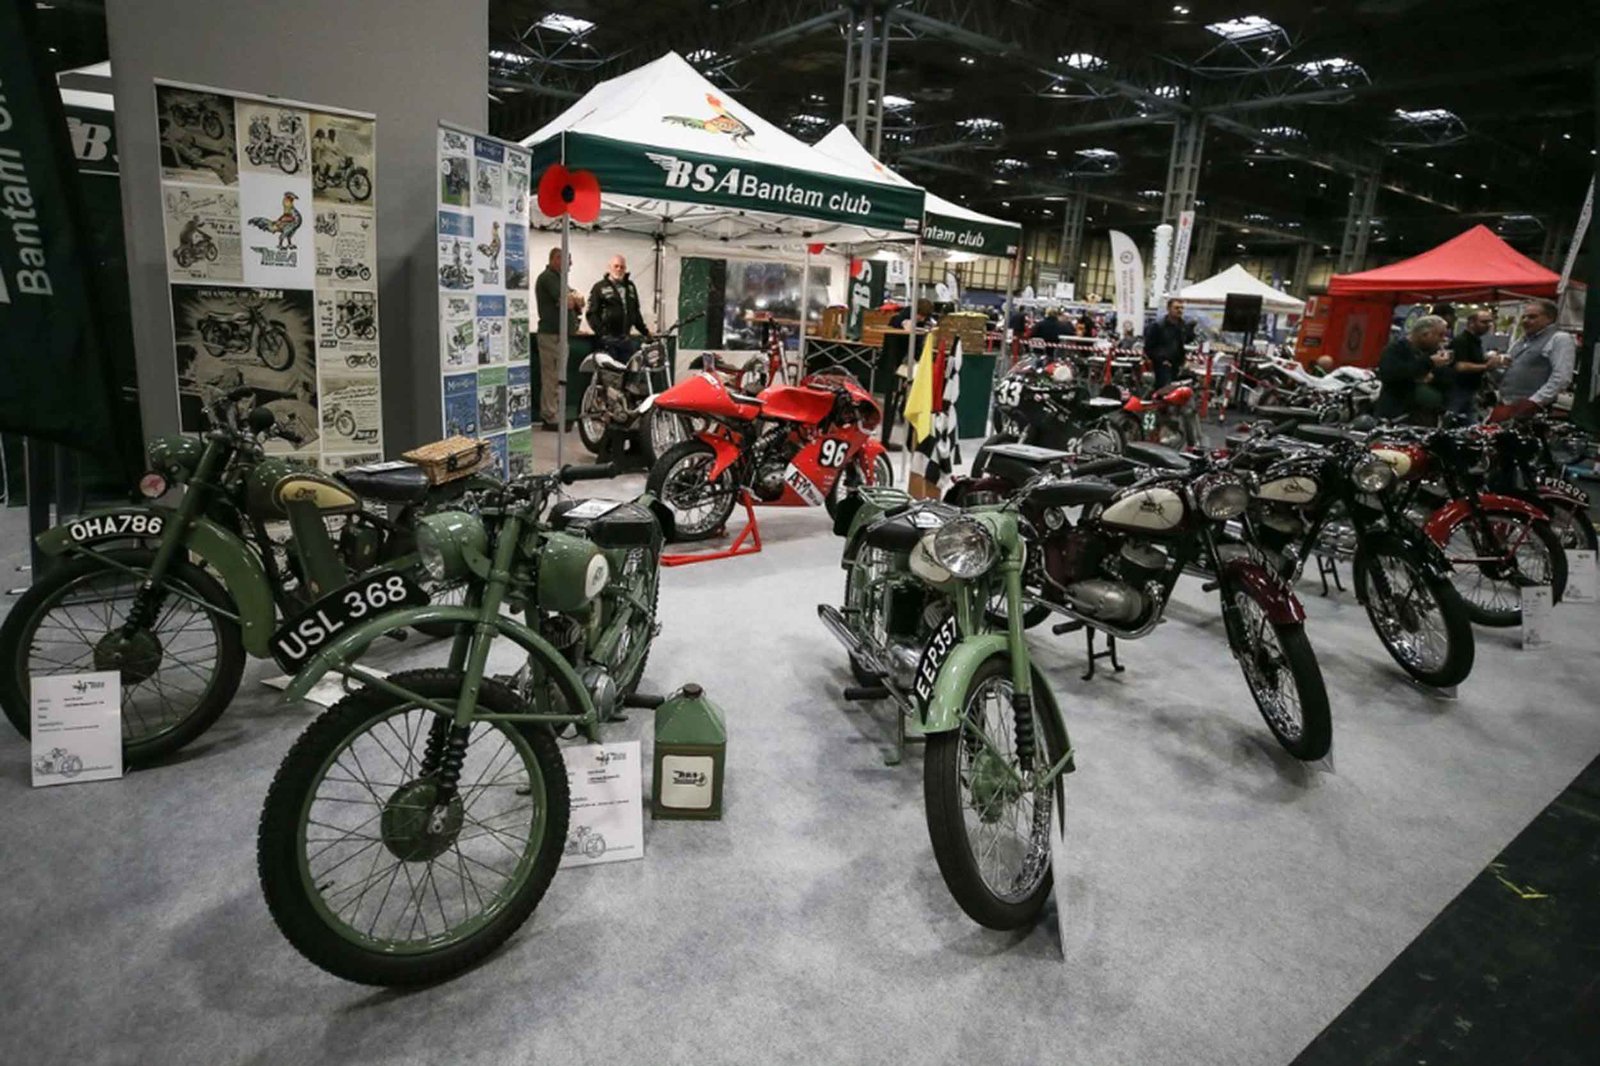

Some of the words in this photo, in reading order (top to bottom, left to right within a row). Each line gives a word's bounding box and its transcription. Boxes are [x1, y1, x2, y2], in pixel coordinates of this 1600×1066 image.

[660, 155, 739, 195] BSA
[741, 174, 823, 208] Bantam
[829, 191, 873, 216] club
[922, 226, 956, 243] ntam
[958, 229, 985, 248] club
[996, 380, 1023, 407] 33
[820, 439, 849, 467] 96
[70, 514, 163, 541] OHA786
[278, 609, 345, 660] USL
[343, 576, 407, 618] 368
[916, 615, 957, 701] EEP357
